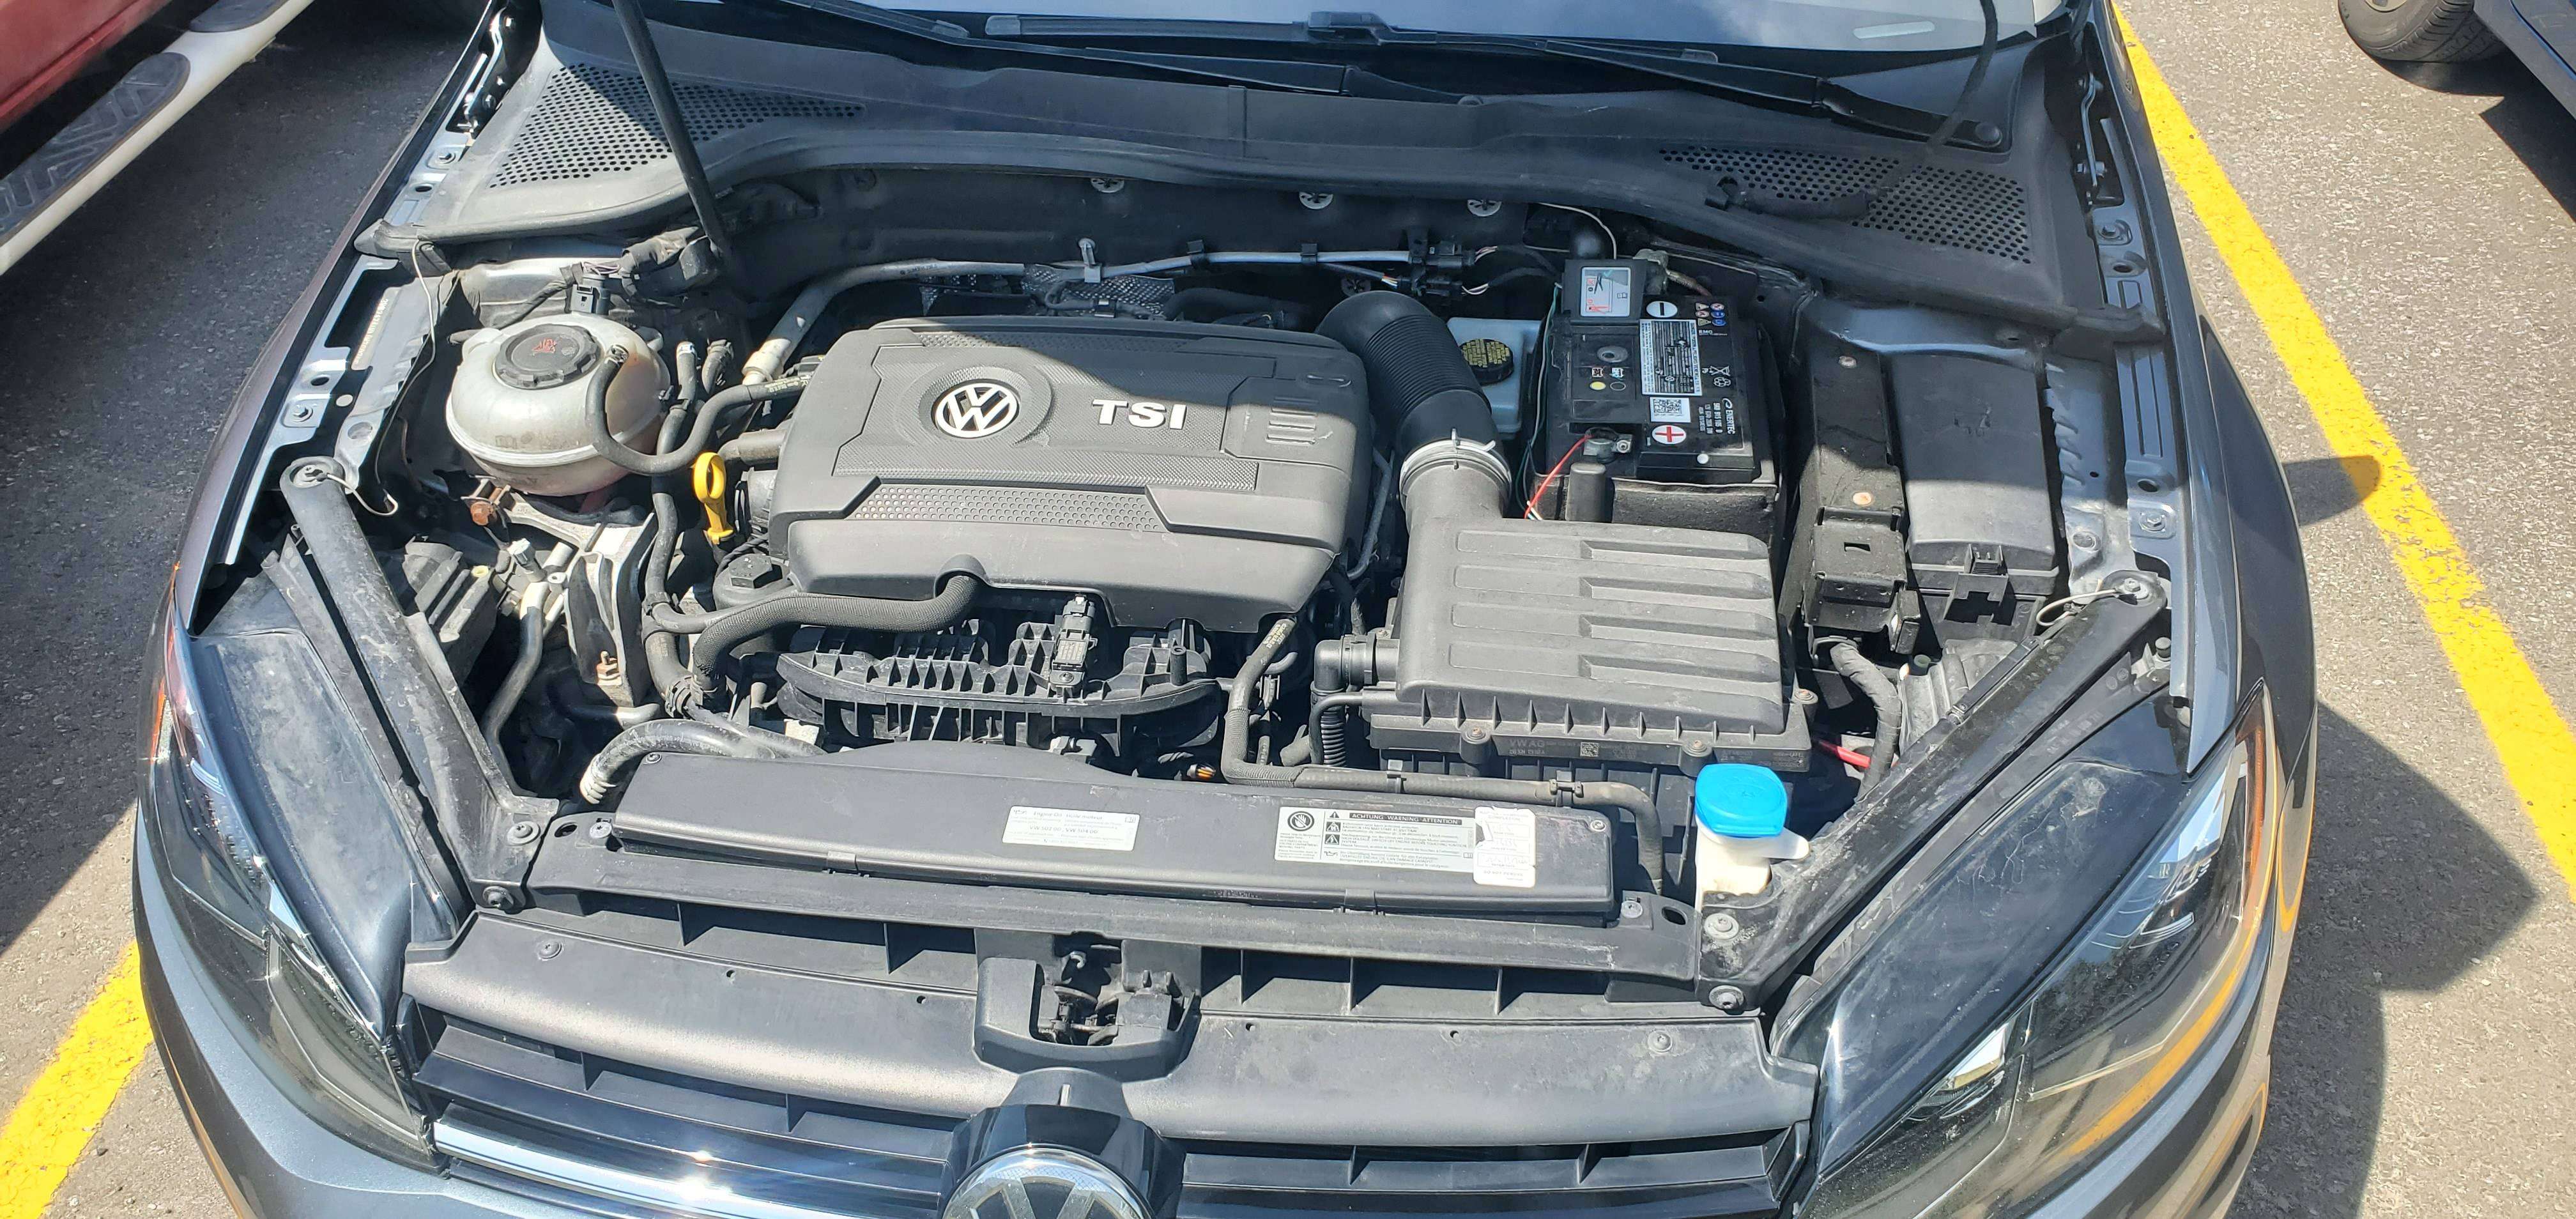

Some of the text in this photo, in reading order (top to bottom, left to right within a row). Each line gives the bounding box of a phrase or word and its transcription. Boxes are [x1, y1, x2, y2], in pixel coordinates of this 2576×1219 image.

[936, 383, 1017, 438] VW
[1092, 399, 1187, 429] TSI
[1726, 410, 1736, 434] ENERTEC
